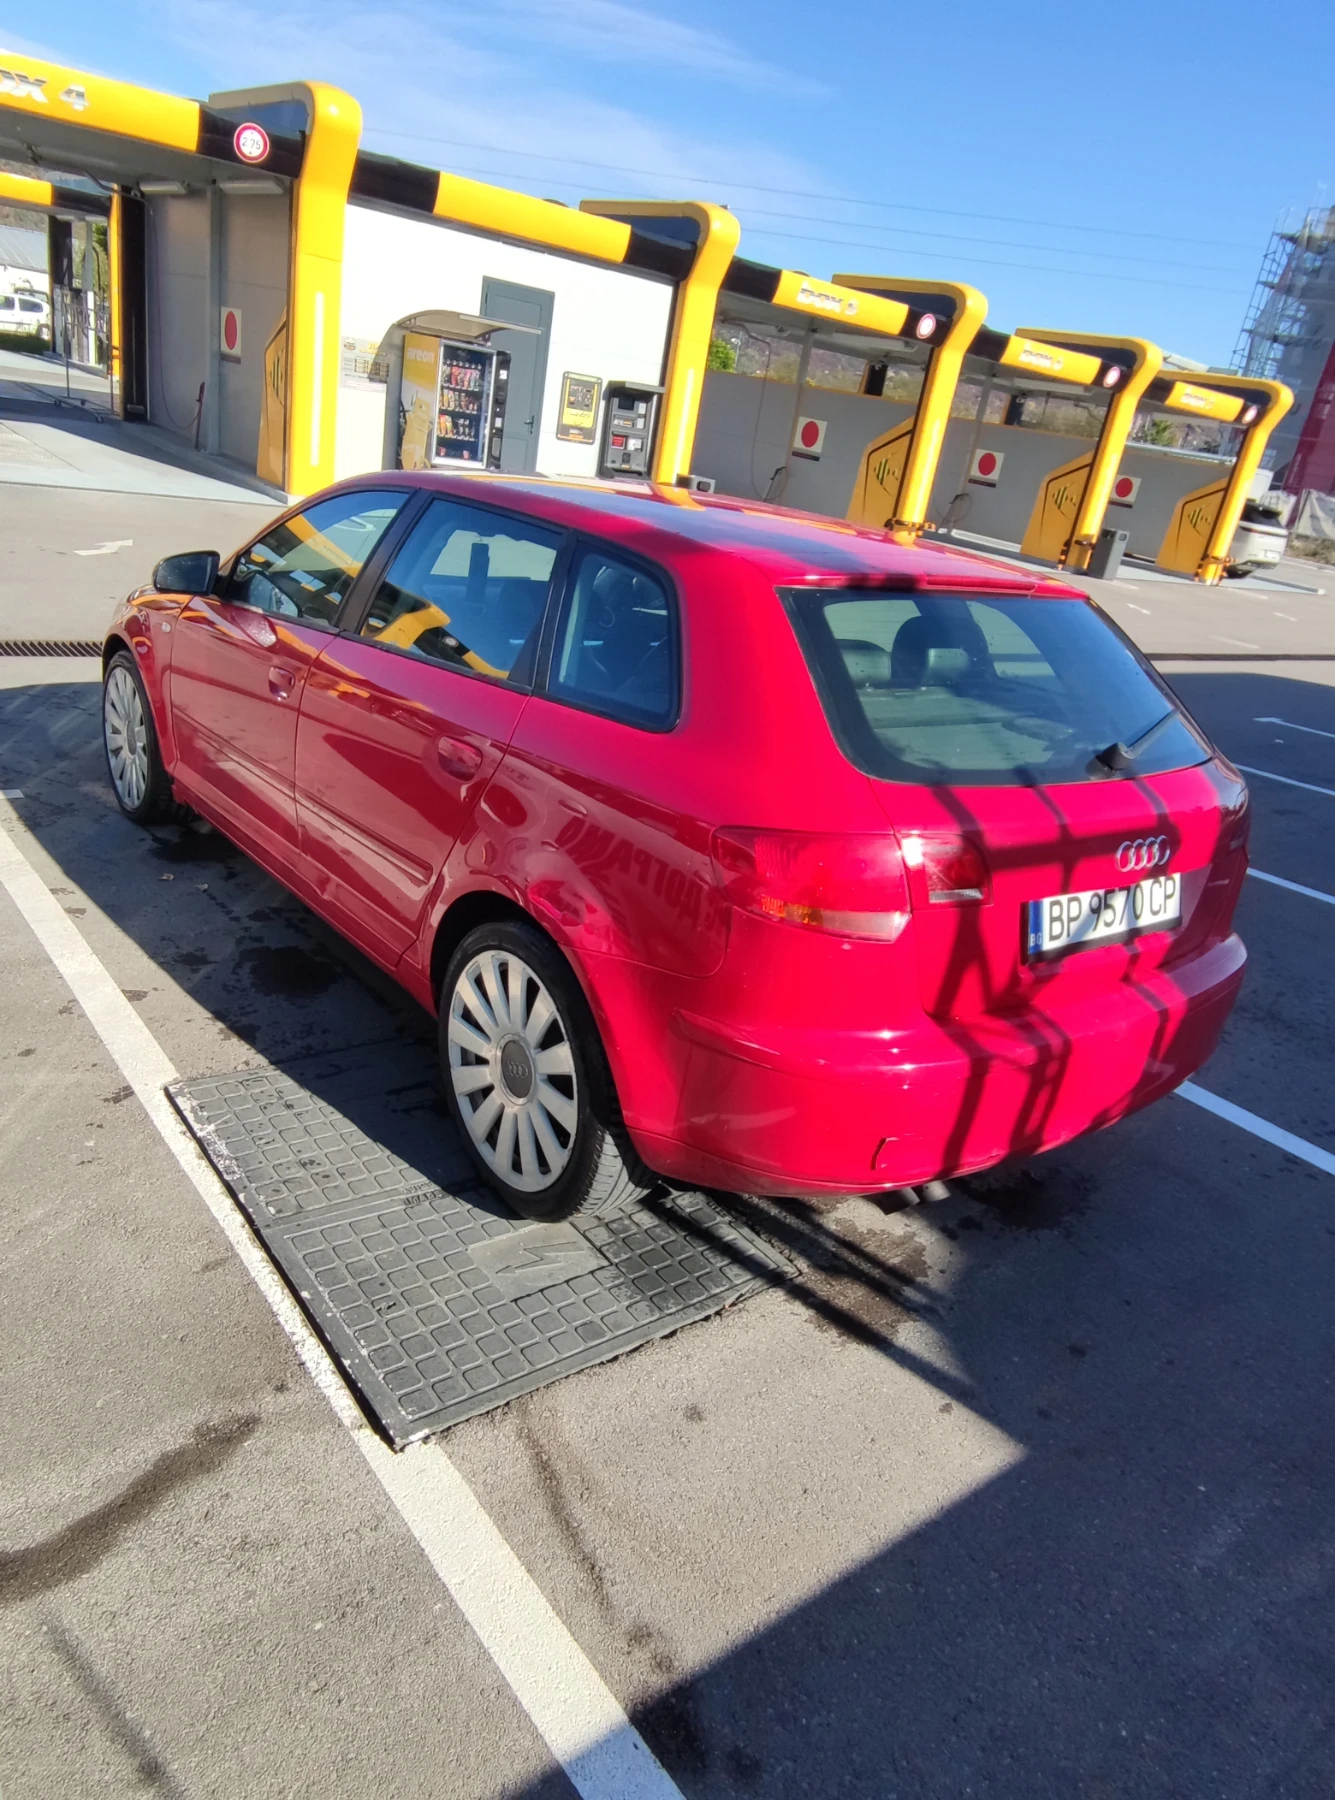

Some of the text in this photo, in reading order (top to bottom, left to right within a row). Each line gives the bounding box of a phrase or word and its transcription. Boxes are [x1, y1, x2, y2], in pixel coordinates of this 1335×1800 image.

[60, 84, 90, 112] 4
[1048, 875, 1176, 942] BP 9570 CP
[1030, 932, 1042, 947] BG
